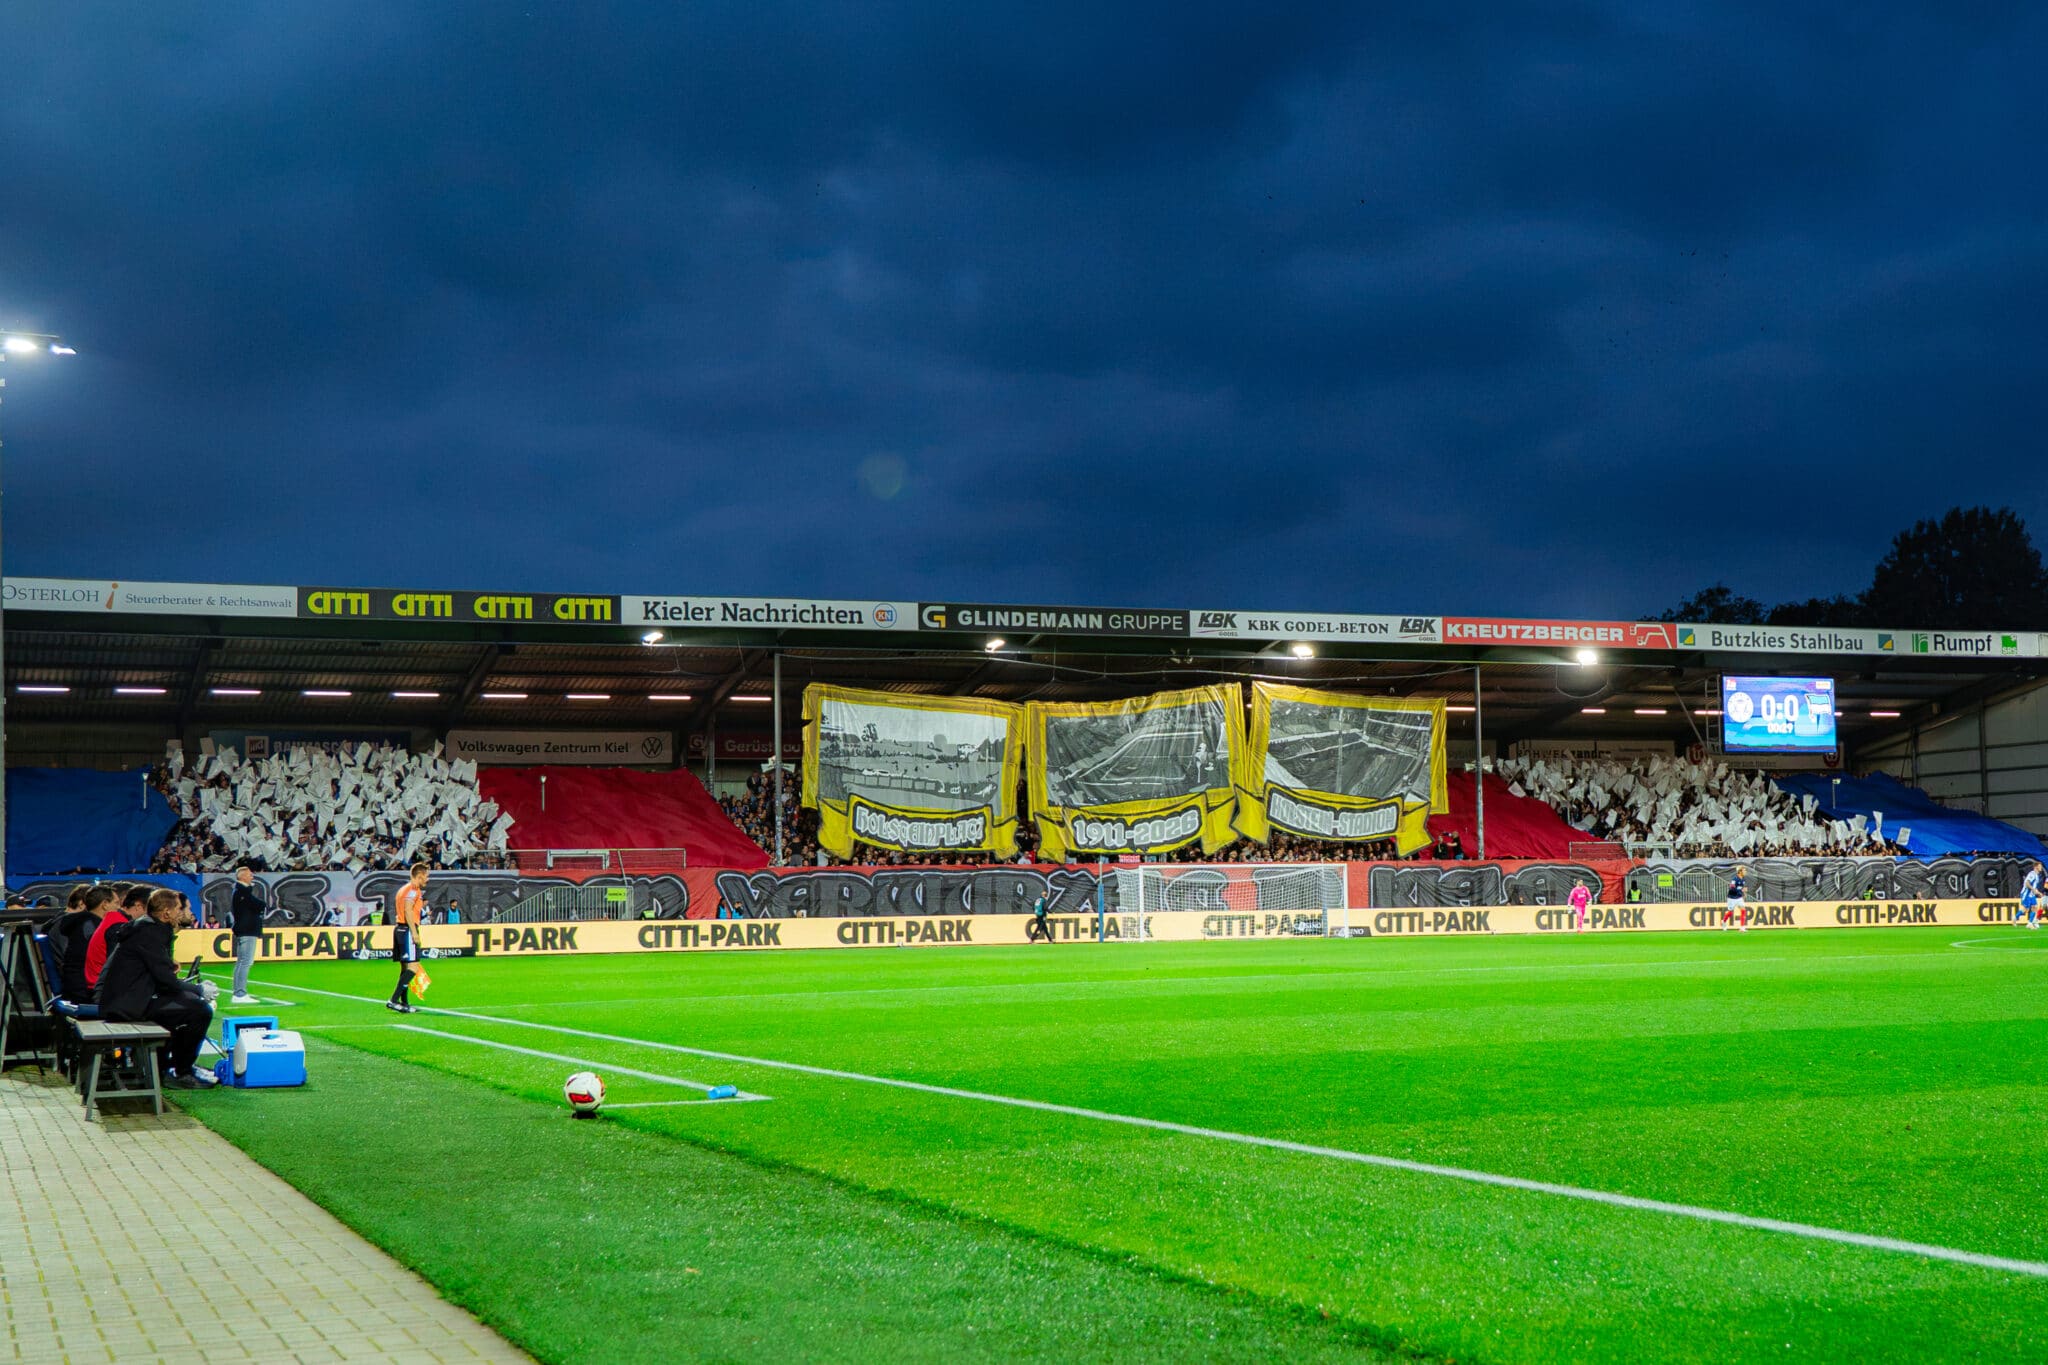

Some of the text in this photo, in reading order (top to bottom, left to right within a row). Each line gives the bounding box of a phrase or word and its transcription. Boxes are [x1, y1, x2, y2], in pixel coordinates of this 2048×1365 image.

[2, 584, 100, 602] OSTERLOH
[125, 593, 292, 608] Steuerberater & Rechtsanwalt
[307, 592, 369, 614] CITTI
[392, 594, 452, 617] CITTI
[474, 596, 533, 619] CITTI
[554, 598, 612, 620] CITTI
[643, 601, 864, 624] Kieler Nachrichten
[875, 609, 894, 622] KN
[957, 610, 1183, 631] GLINDEMANN GRUPPE
[1198, 612, 1238, 628] KBK
[1247, 619, 1389, 634] KBK GODEL-BETON
[1399, 618, 1436, 634] KBK
[1447, 623, 1624, 642] KREUTZBERGER
[1711, 630, 1863, 651] Butzkies Stahlbau
[1934, 634, 1993, 655] Rumpf
[1761, 694, 1799, 722] 0:0
[457, 739, 629, 755] Volkswagen Zentrum Kiel
[1073, 809, 1200, 847] 1911-2026
[1374, 911, 1490, 933] CITTI-PARK
[1536, 908, 1646, 930] CITT-PARK
[1835, 903, 1937, 924] CITTI-PARK
[638, 923, 782, 949] CITTI-PARK
[837, 919, 973, 944] CITTI-PARK
